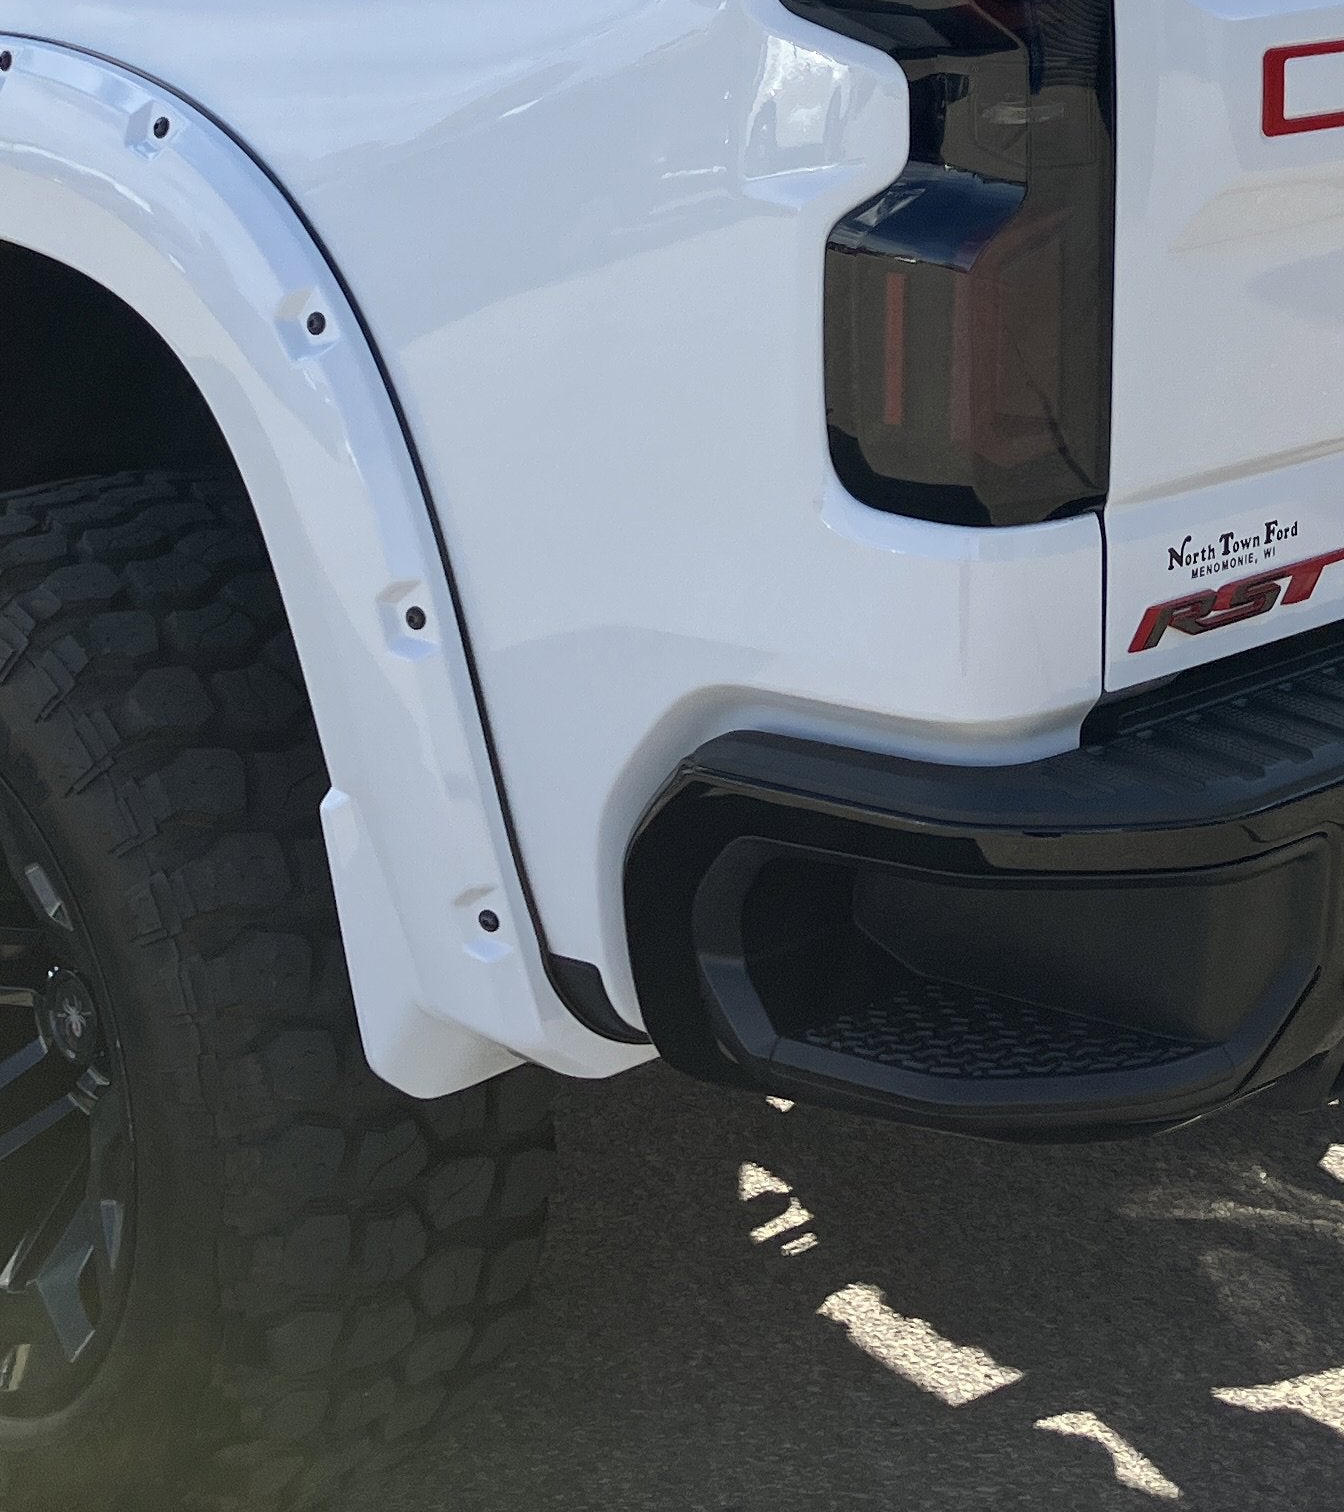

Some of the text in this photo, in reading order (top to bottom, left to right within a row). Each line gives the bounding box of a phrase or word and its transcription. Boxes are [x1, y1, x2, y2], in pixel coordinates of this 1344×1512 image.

[1167, 520, 1299, 571] North Town Ford
[1263, 546, 1276, 560] WI
